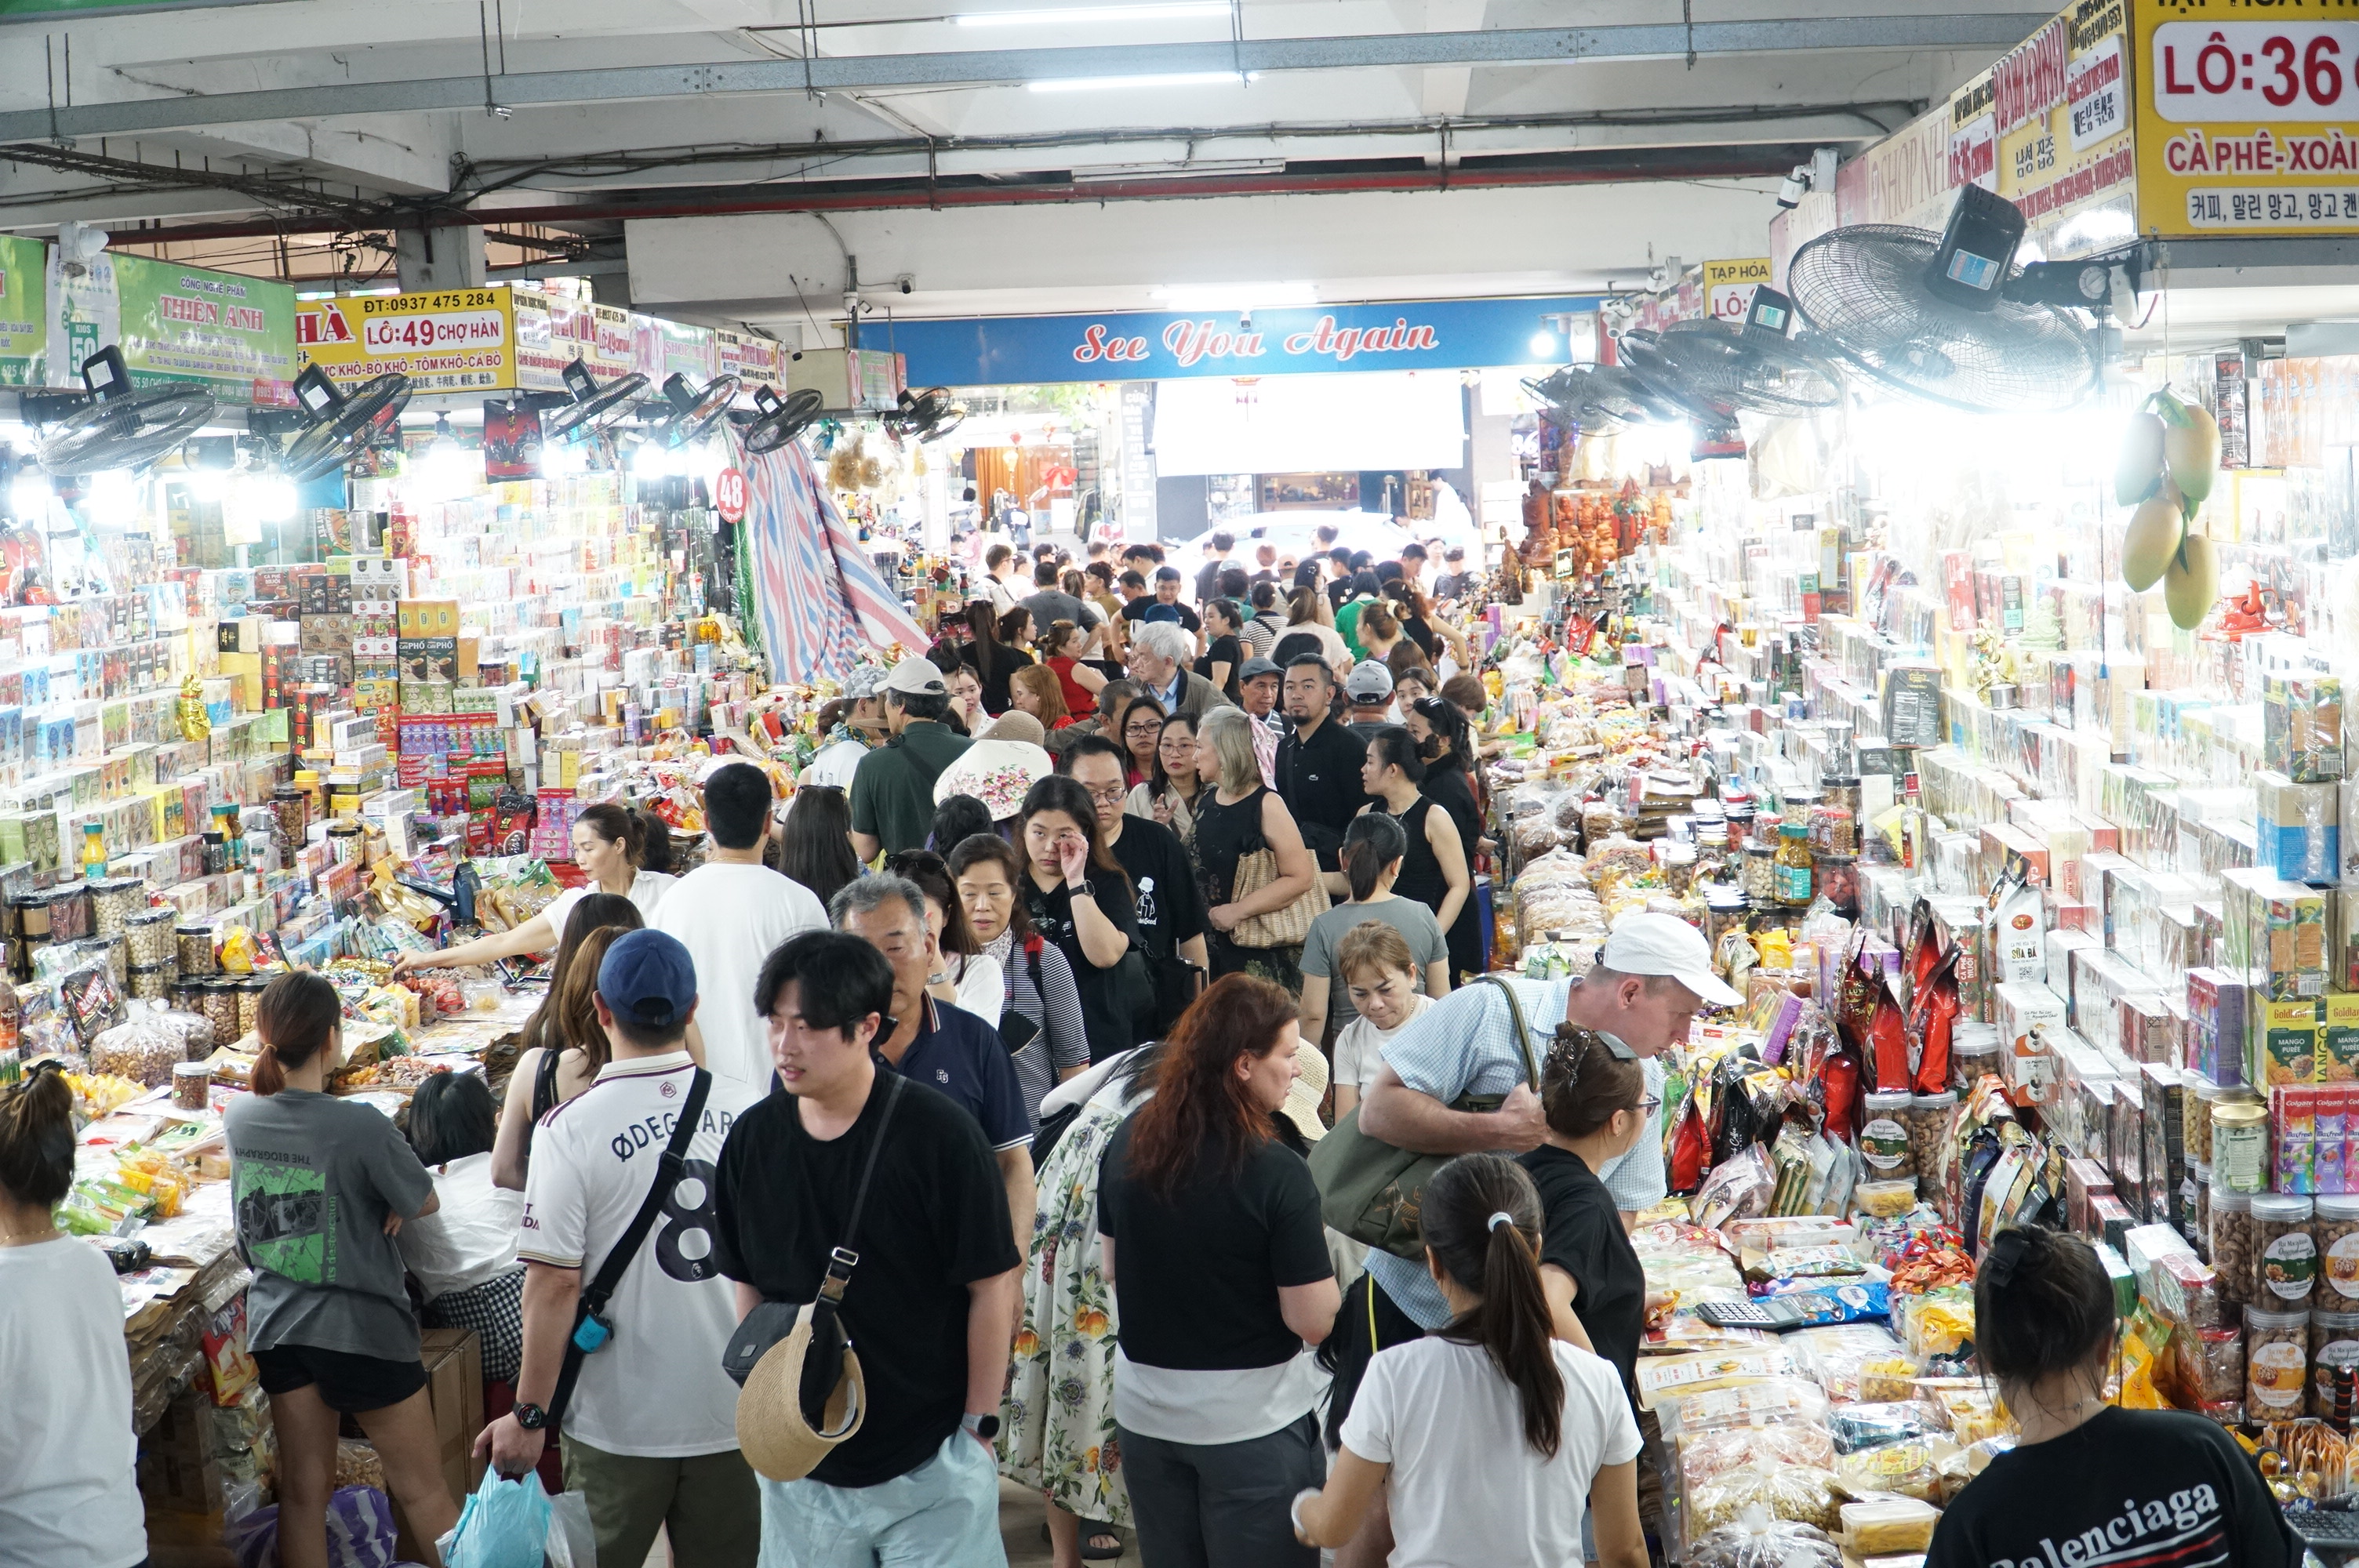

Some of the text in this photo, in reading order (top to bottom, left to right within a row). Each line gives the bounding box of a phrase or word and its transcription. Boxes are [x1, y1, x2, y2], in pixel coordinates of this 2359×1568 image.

[2164, 31, 2343, 107] LÔ:36
[1994, 48, 2026, 135] NAM
[2168, 132, 2209, 172] CÀ
[1881, 137, 1917, 221] SHOP
[2191, 194, 2226, 222] 커피,
[2233, 194, 2262, 220] 말린
[2268, 194, 2303, 220] 망고,
[2309, 194, 2338, 220] 망고
[180, 276, 201, 290] CÔNG
[1710, 261, 1768, 281] TẠP HÓA
[160, 294, 264, 331] THIỆN ANH
[364, 296, 427, 313] ĐT:0937
[433, 294, 460, 308] 475
[467, 292, 495, 306] 284
[75, 325, 92, 333] KIOS
[367, 320, 434, 347] LÔ:49
[437, 323, 467, 343] CHỢ
[471, 318, 499, 338] HÀN
[1073, 314, 1440, 368] See You Again
[71, 336, 97, 374] 50
[384, 358, 408, 374] KHÔ
[415, 356, 438, 371] TÔM
[440, 352, 484, 369] KHÔ-CÁ
[485, 350, 501, 366] BÒ
[665, 340, 689, 356] SHOP
[1510, 430, 1539, 456] 86
[720, 474, 743, 509] 48
[409, 640, 425, 649] PHỐ
[436, 640, 453, 649] PHỐ
[611, 1109, 740, 1163] ØDEGAR
[292, 1152, 311, 1165] THE
[655, 1159, 723, 1283] 8
